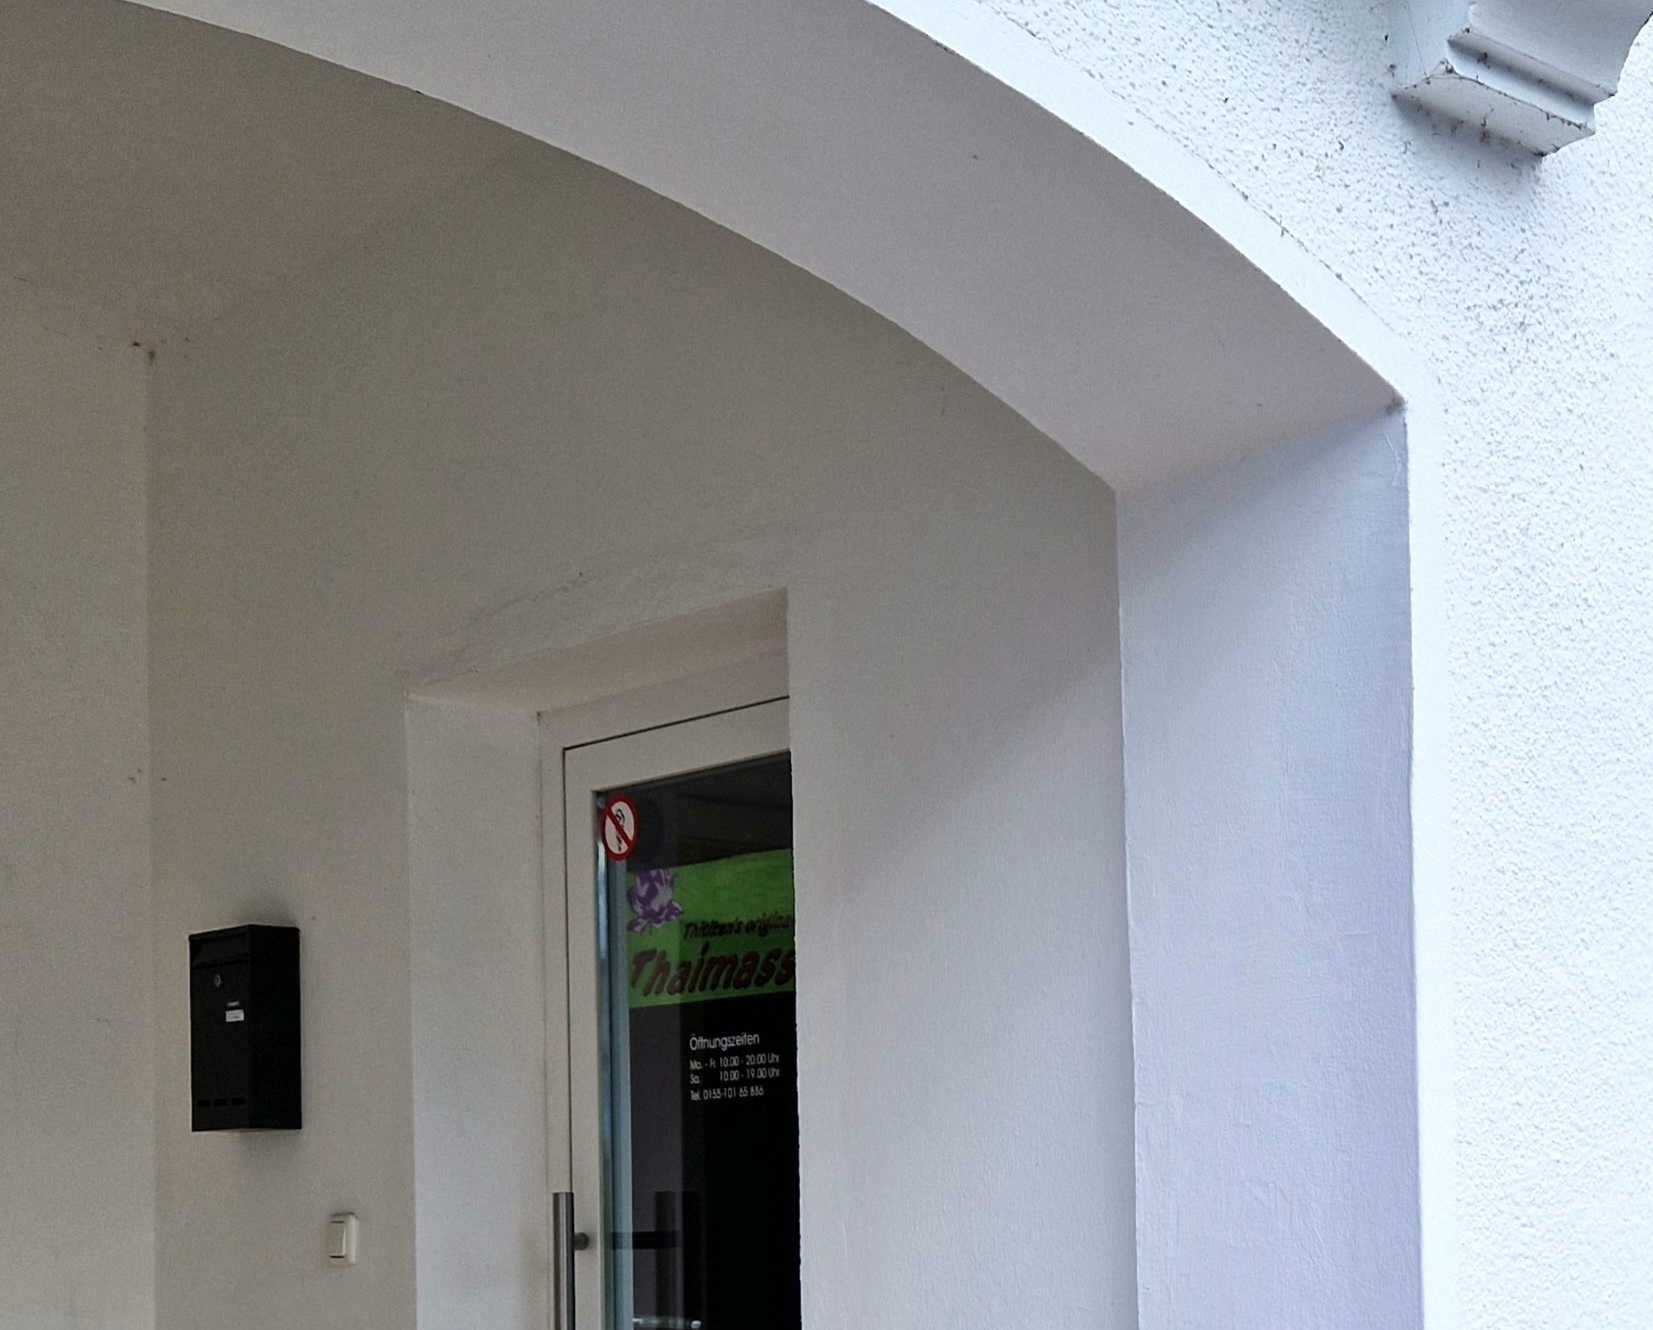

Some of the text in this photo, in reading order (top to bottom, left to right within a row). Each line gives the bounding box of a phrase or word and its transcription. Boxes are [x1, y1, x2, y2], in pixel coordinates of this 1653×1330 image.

[631, 940, 795, 997] Thaimass
[689, 1031, 760, 1051] Öffnungszeiten
[767, 1052, 780, 1064] Uhr
[767, 1067, 780, 1078] Uhr
